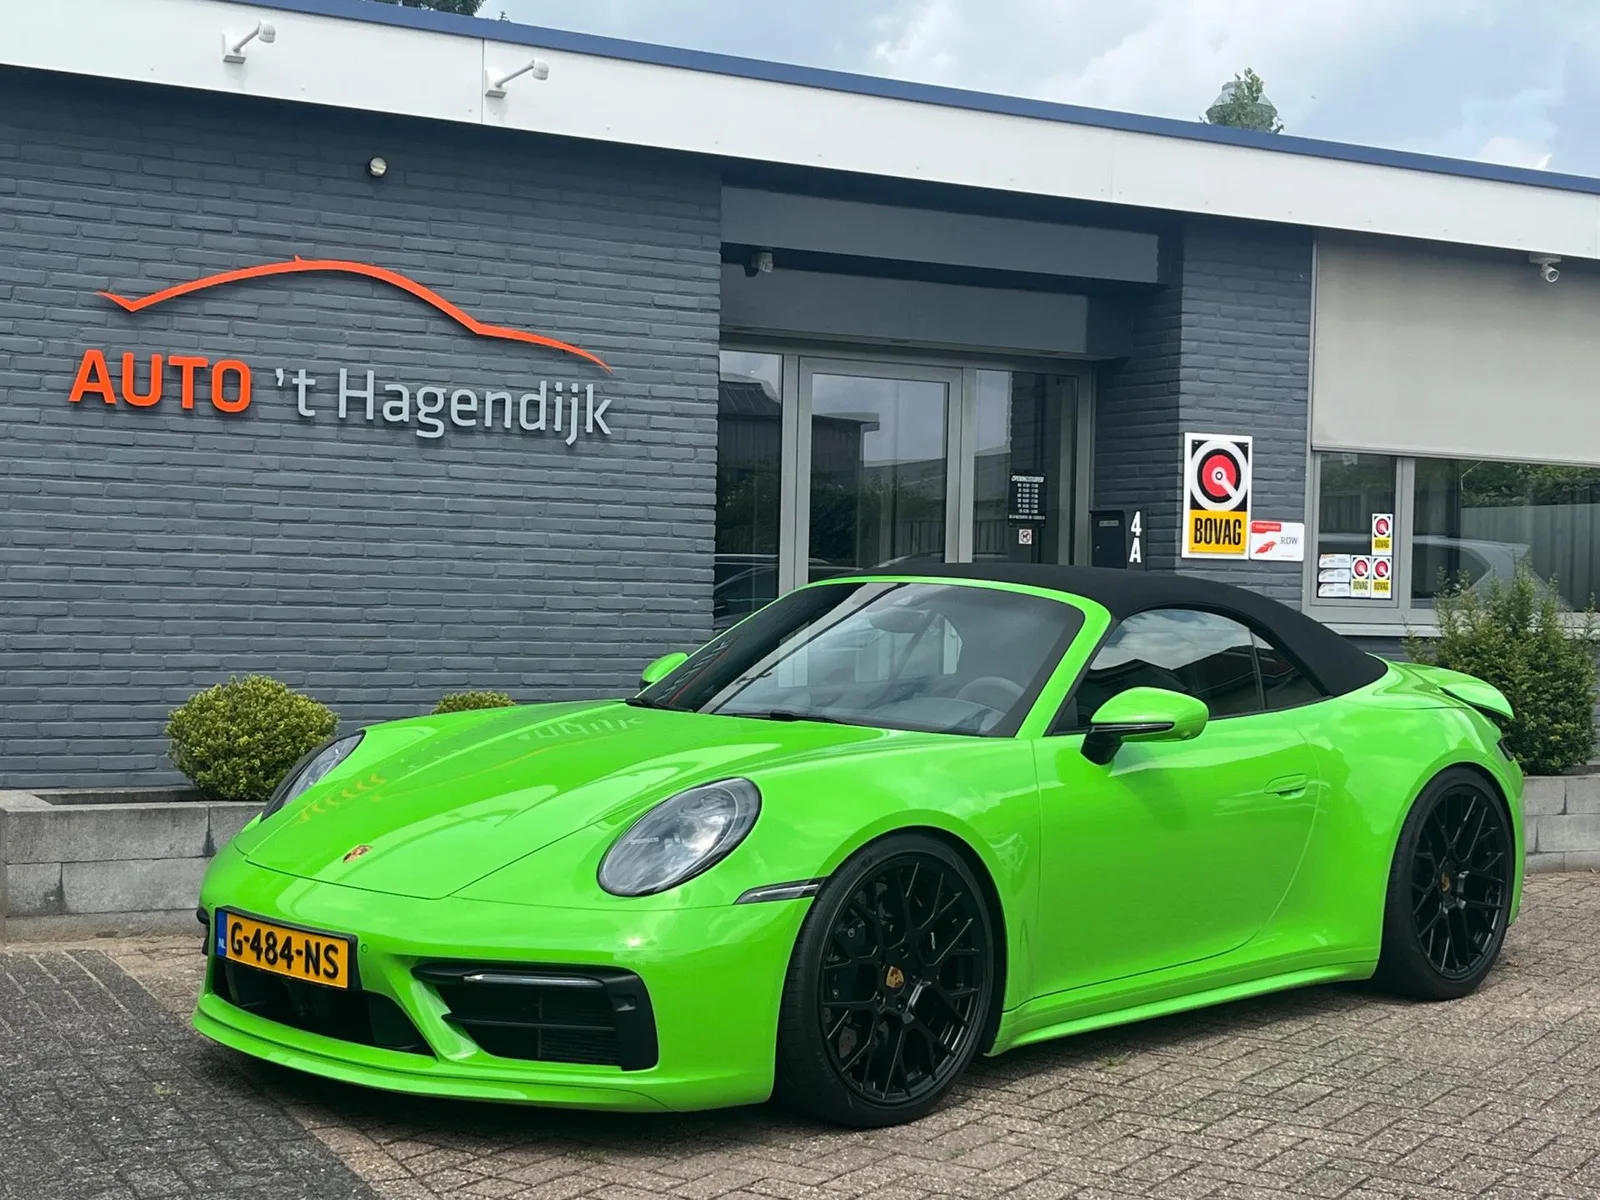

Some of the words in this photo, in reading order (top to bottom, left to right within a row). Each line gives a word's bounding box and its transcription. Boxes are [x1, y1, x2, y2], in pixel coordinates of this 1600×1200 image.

[68, 349, 252, 413] AUTO
[337, 367, 613, 446] Hagendijk
[1130, 511, 1142, 536] 4
[1193, 517, 1242, 546] BOVAG
[1129, 537, 1142, 563] A
[1280, 536, 1299, 545] RDW
[1353, 580, 1369, 591] BOVAG
[1374, 581, 1389, 591] BOVAG
[218, 937, 227, 950] NL
[230, 921, 340, 979] G-484-NS
